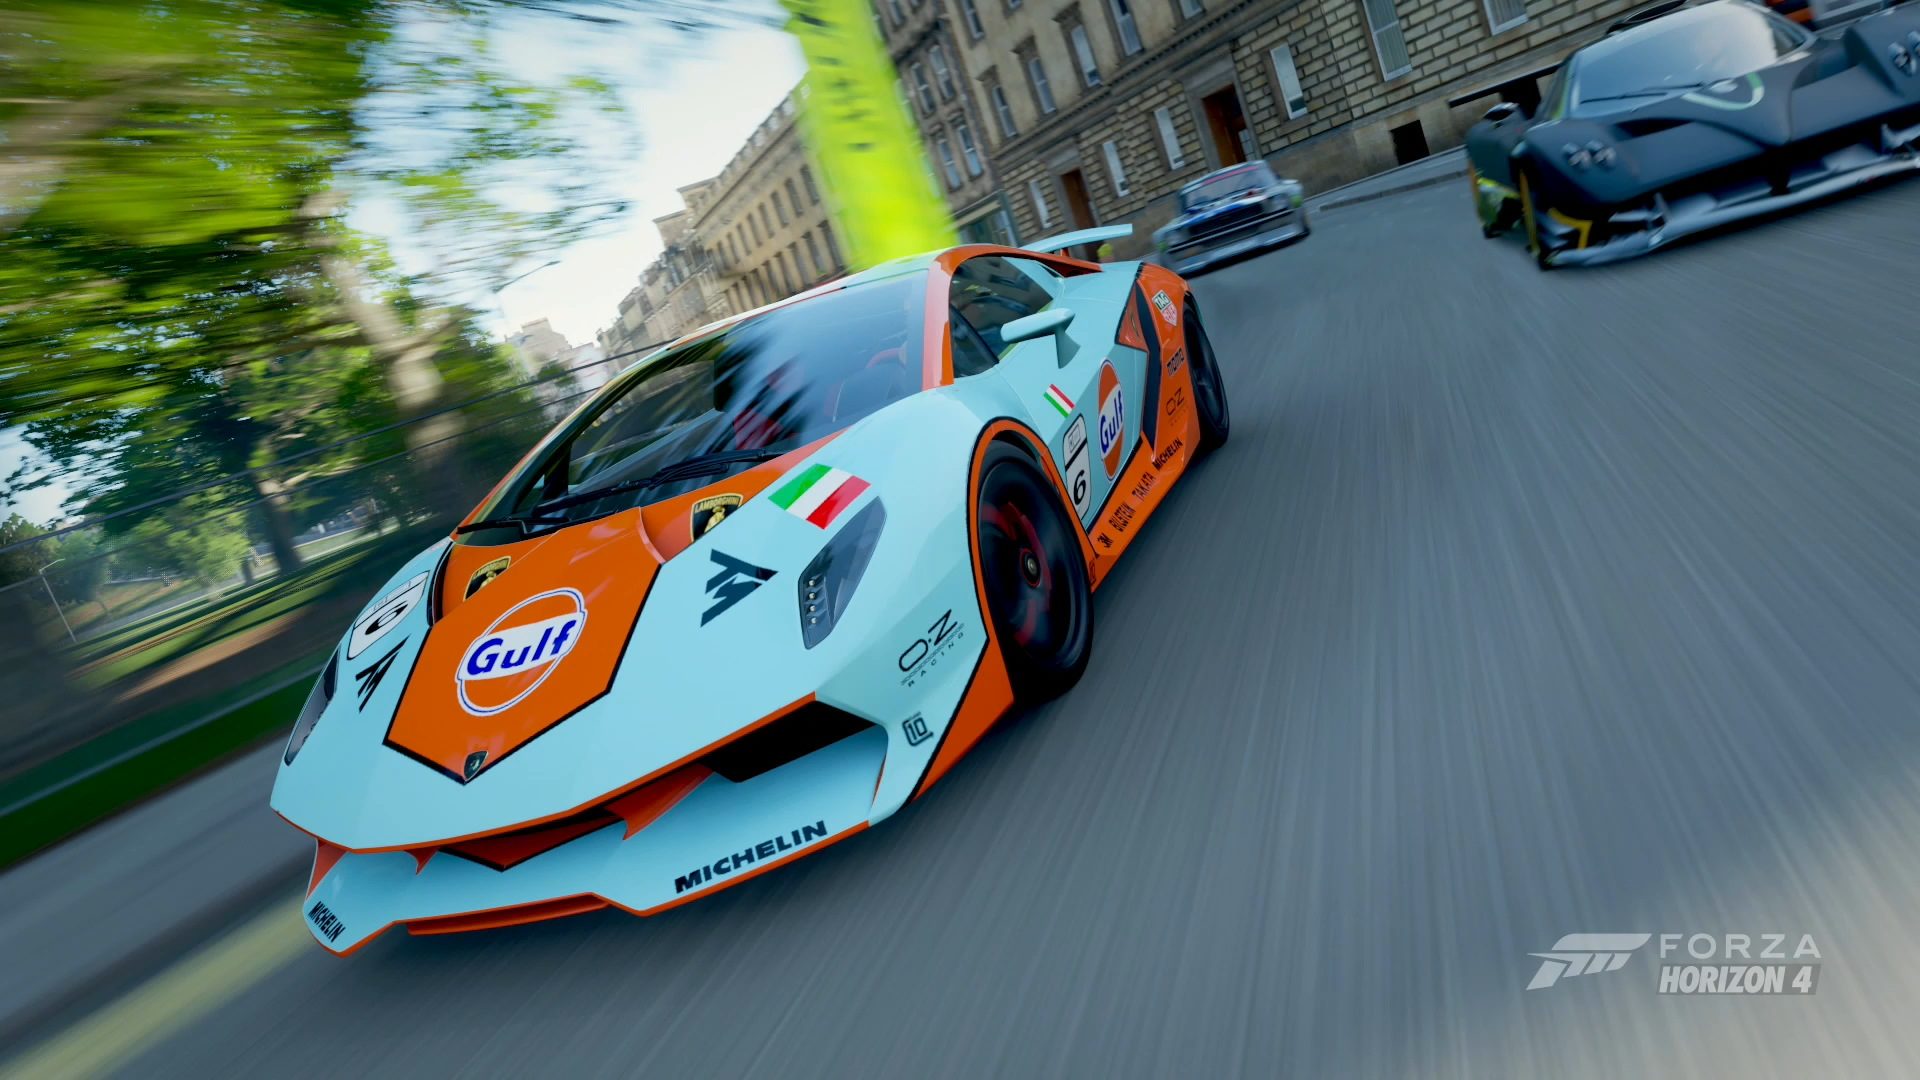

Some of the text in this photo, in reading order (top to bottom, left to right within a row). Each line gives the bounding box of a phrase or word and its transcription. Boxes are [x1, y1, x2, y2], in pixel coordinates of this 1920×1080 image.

[1155, 291, 1171, 310] TAG
[1100, 391, 1124, 453] Gulf
[1073, 469, 1087, 506] 6
[1109, 500, 1136, 532] BILSTEIN
[1131, 471, 1156, 501] TAKATA
[1152, 438, 1183, 471] MICHELIN
[365, 600, 408, 635] 6
[466, 619, 578, 677] Gulf
[907, 632, 965, 688] RACING
[675, 820, 829, 894] MICHELIN
[307, 901, 345, 943] MICHELIN
